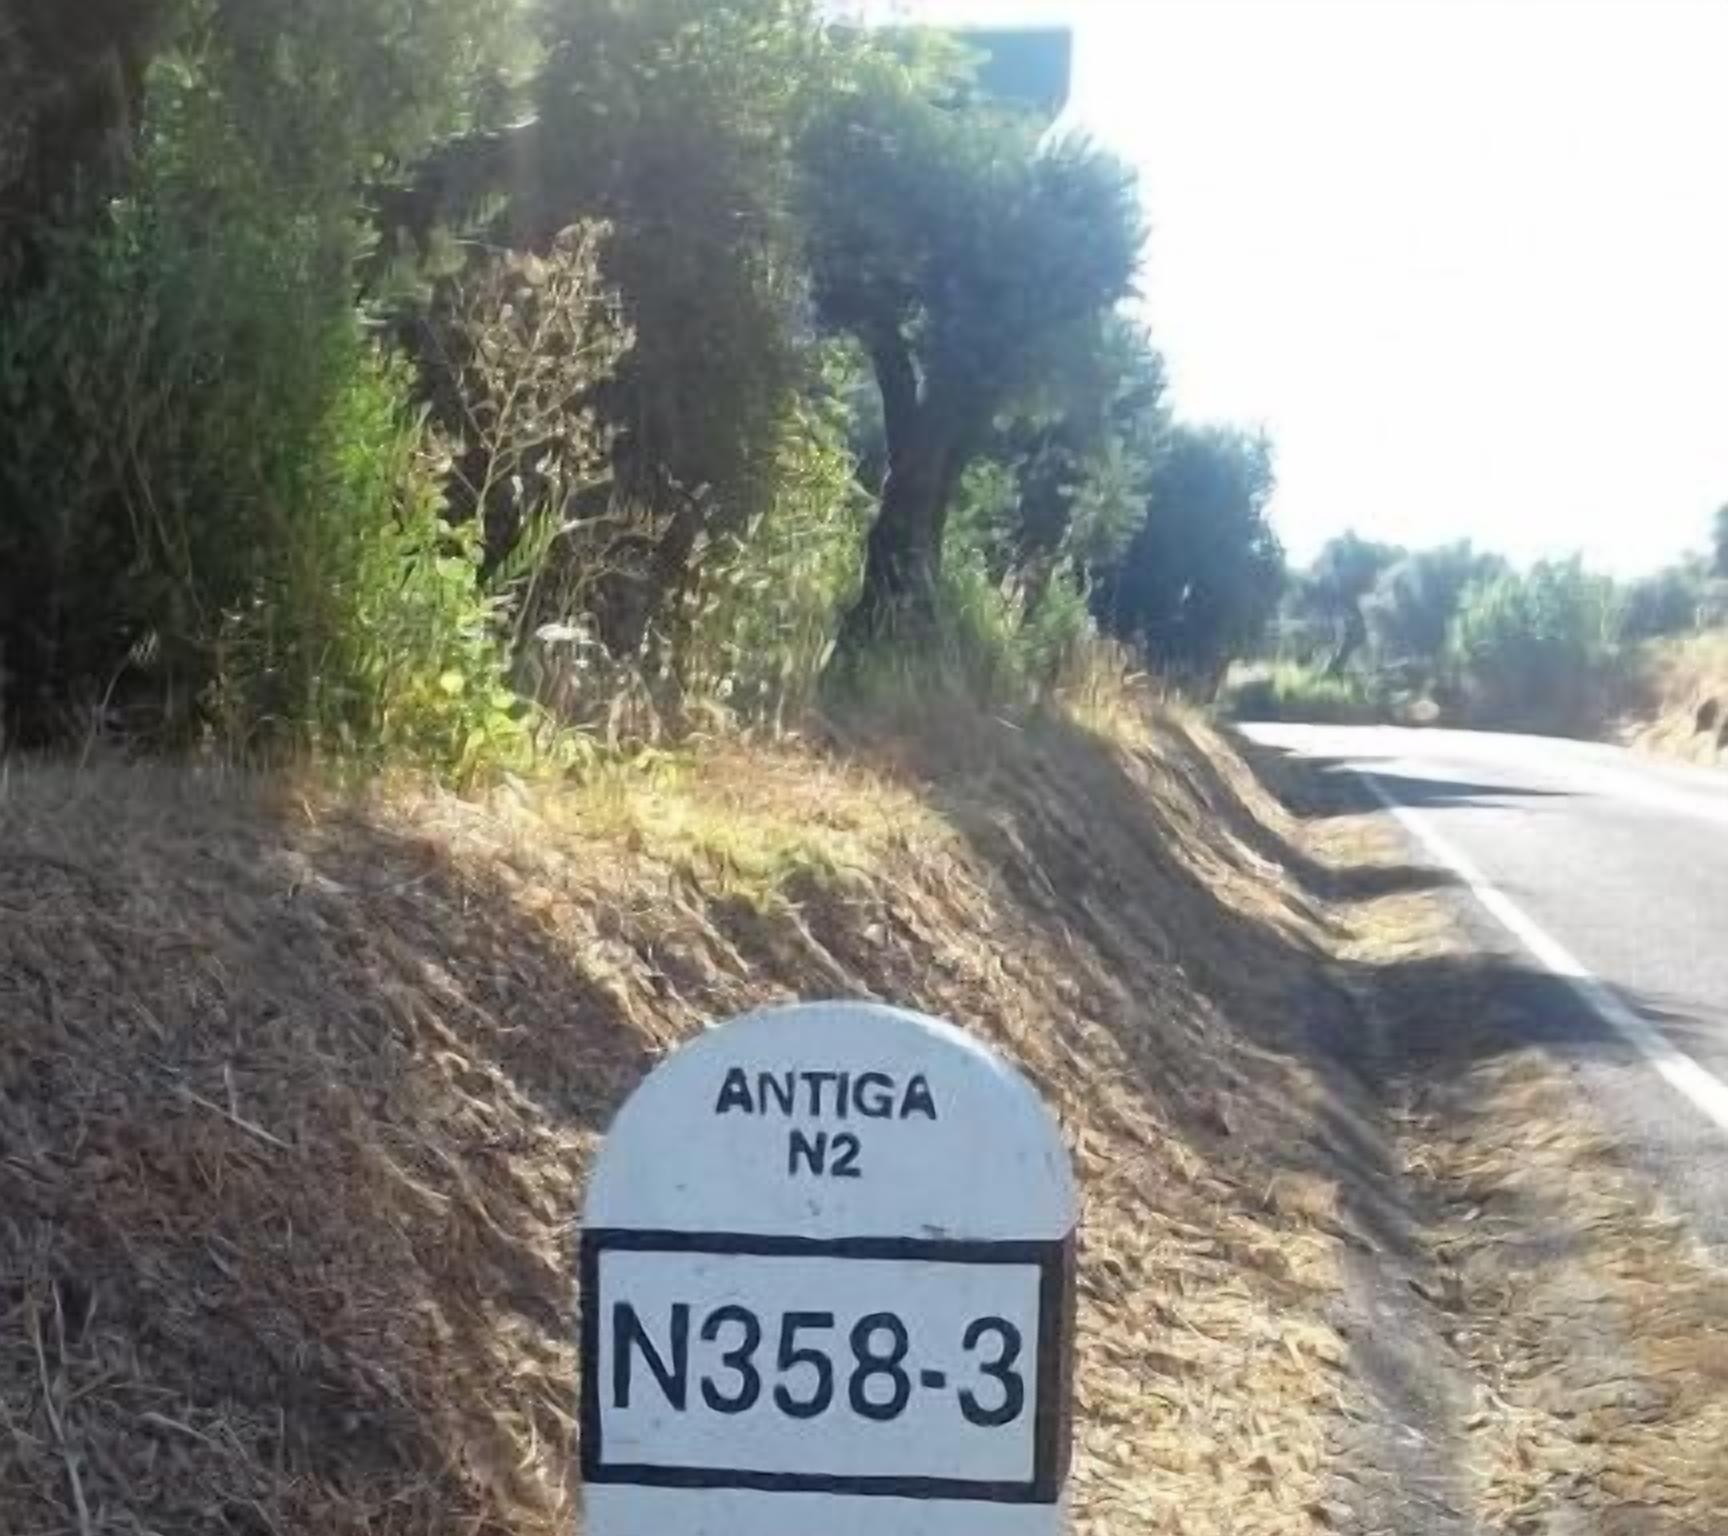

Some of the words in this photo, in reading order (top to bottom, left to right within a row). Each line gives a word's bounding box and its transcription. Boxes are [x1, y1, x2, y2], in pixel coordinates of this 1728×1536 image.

[714, 1067, 938, 1121] ANTIGA
[788, 1129, 862, 1178] N2
[612, 1301, 1026, 1428] N358-3
